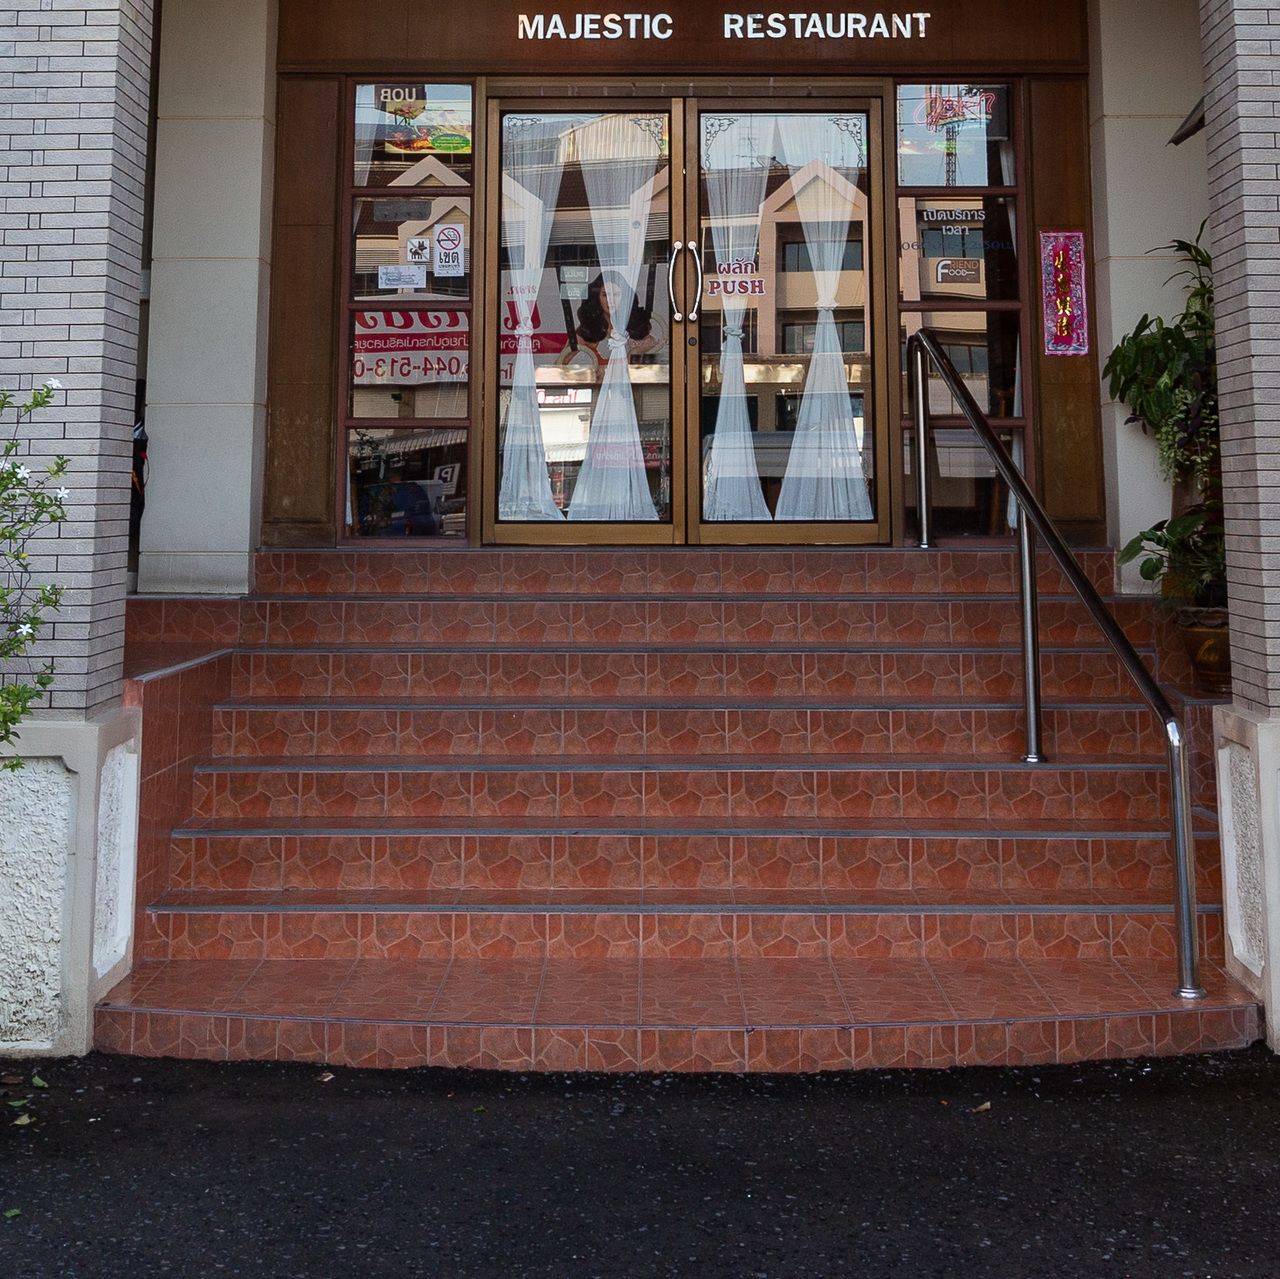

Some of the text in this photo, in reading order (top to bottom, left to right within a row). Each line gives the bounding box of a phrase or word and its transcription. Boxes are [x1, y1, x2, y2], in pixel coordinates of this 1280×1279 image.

[518, 13, 931, 40] MAJESTIC RESTAURANT
[923, 208, 986, 221] เปิดบริการ
[942, 225, 970, 236] เวลา
[718, 258, 755, 274] ผลัก
[708, 279, 765, 295] PUSH
